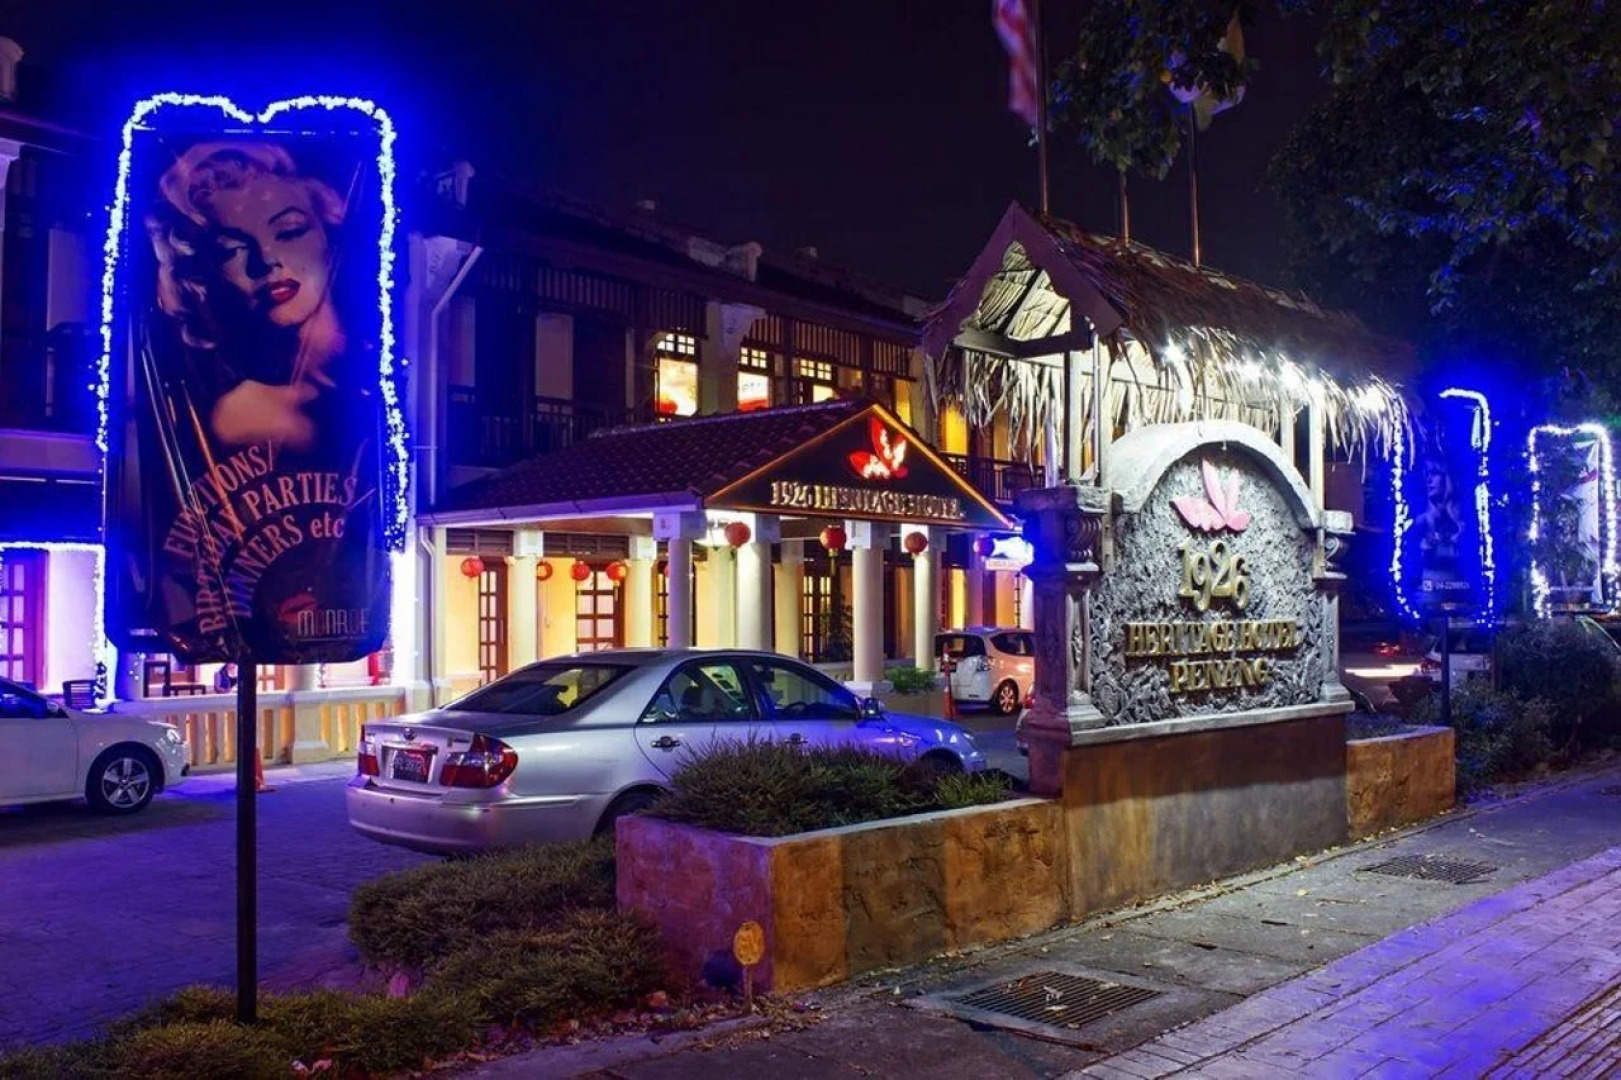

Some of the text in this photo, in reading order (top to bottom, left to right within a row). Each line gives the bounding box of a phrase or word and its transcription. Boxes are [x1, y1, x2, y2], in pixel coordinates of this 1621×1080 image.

[243, 472, 359, 521] PARTIES
[770, 481, 965, 519] 1926 HERITAGE HOTEL
[225, 511, 345, 619] DINNERS etc
[1178, 537, 1250, 611] 1926
[297, 608, 370, 635] MONROE
[1125, 618, 1303, 656] HERITAGE HOTEL
[1170, 658, 1273, 693] PENANG
